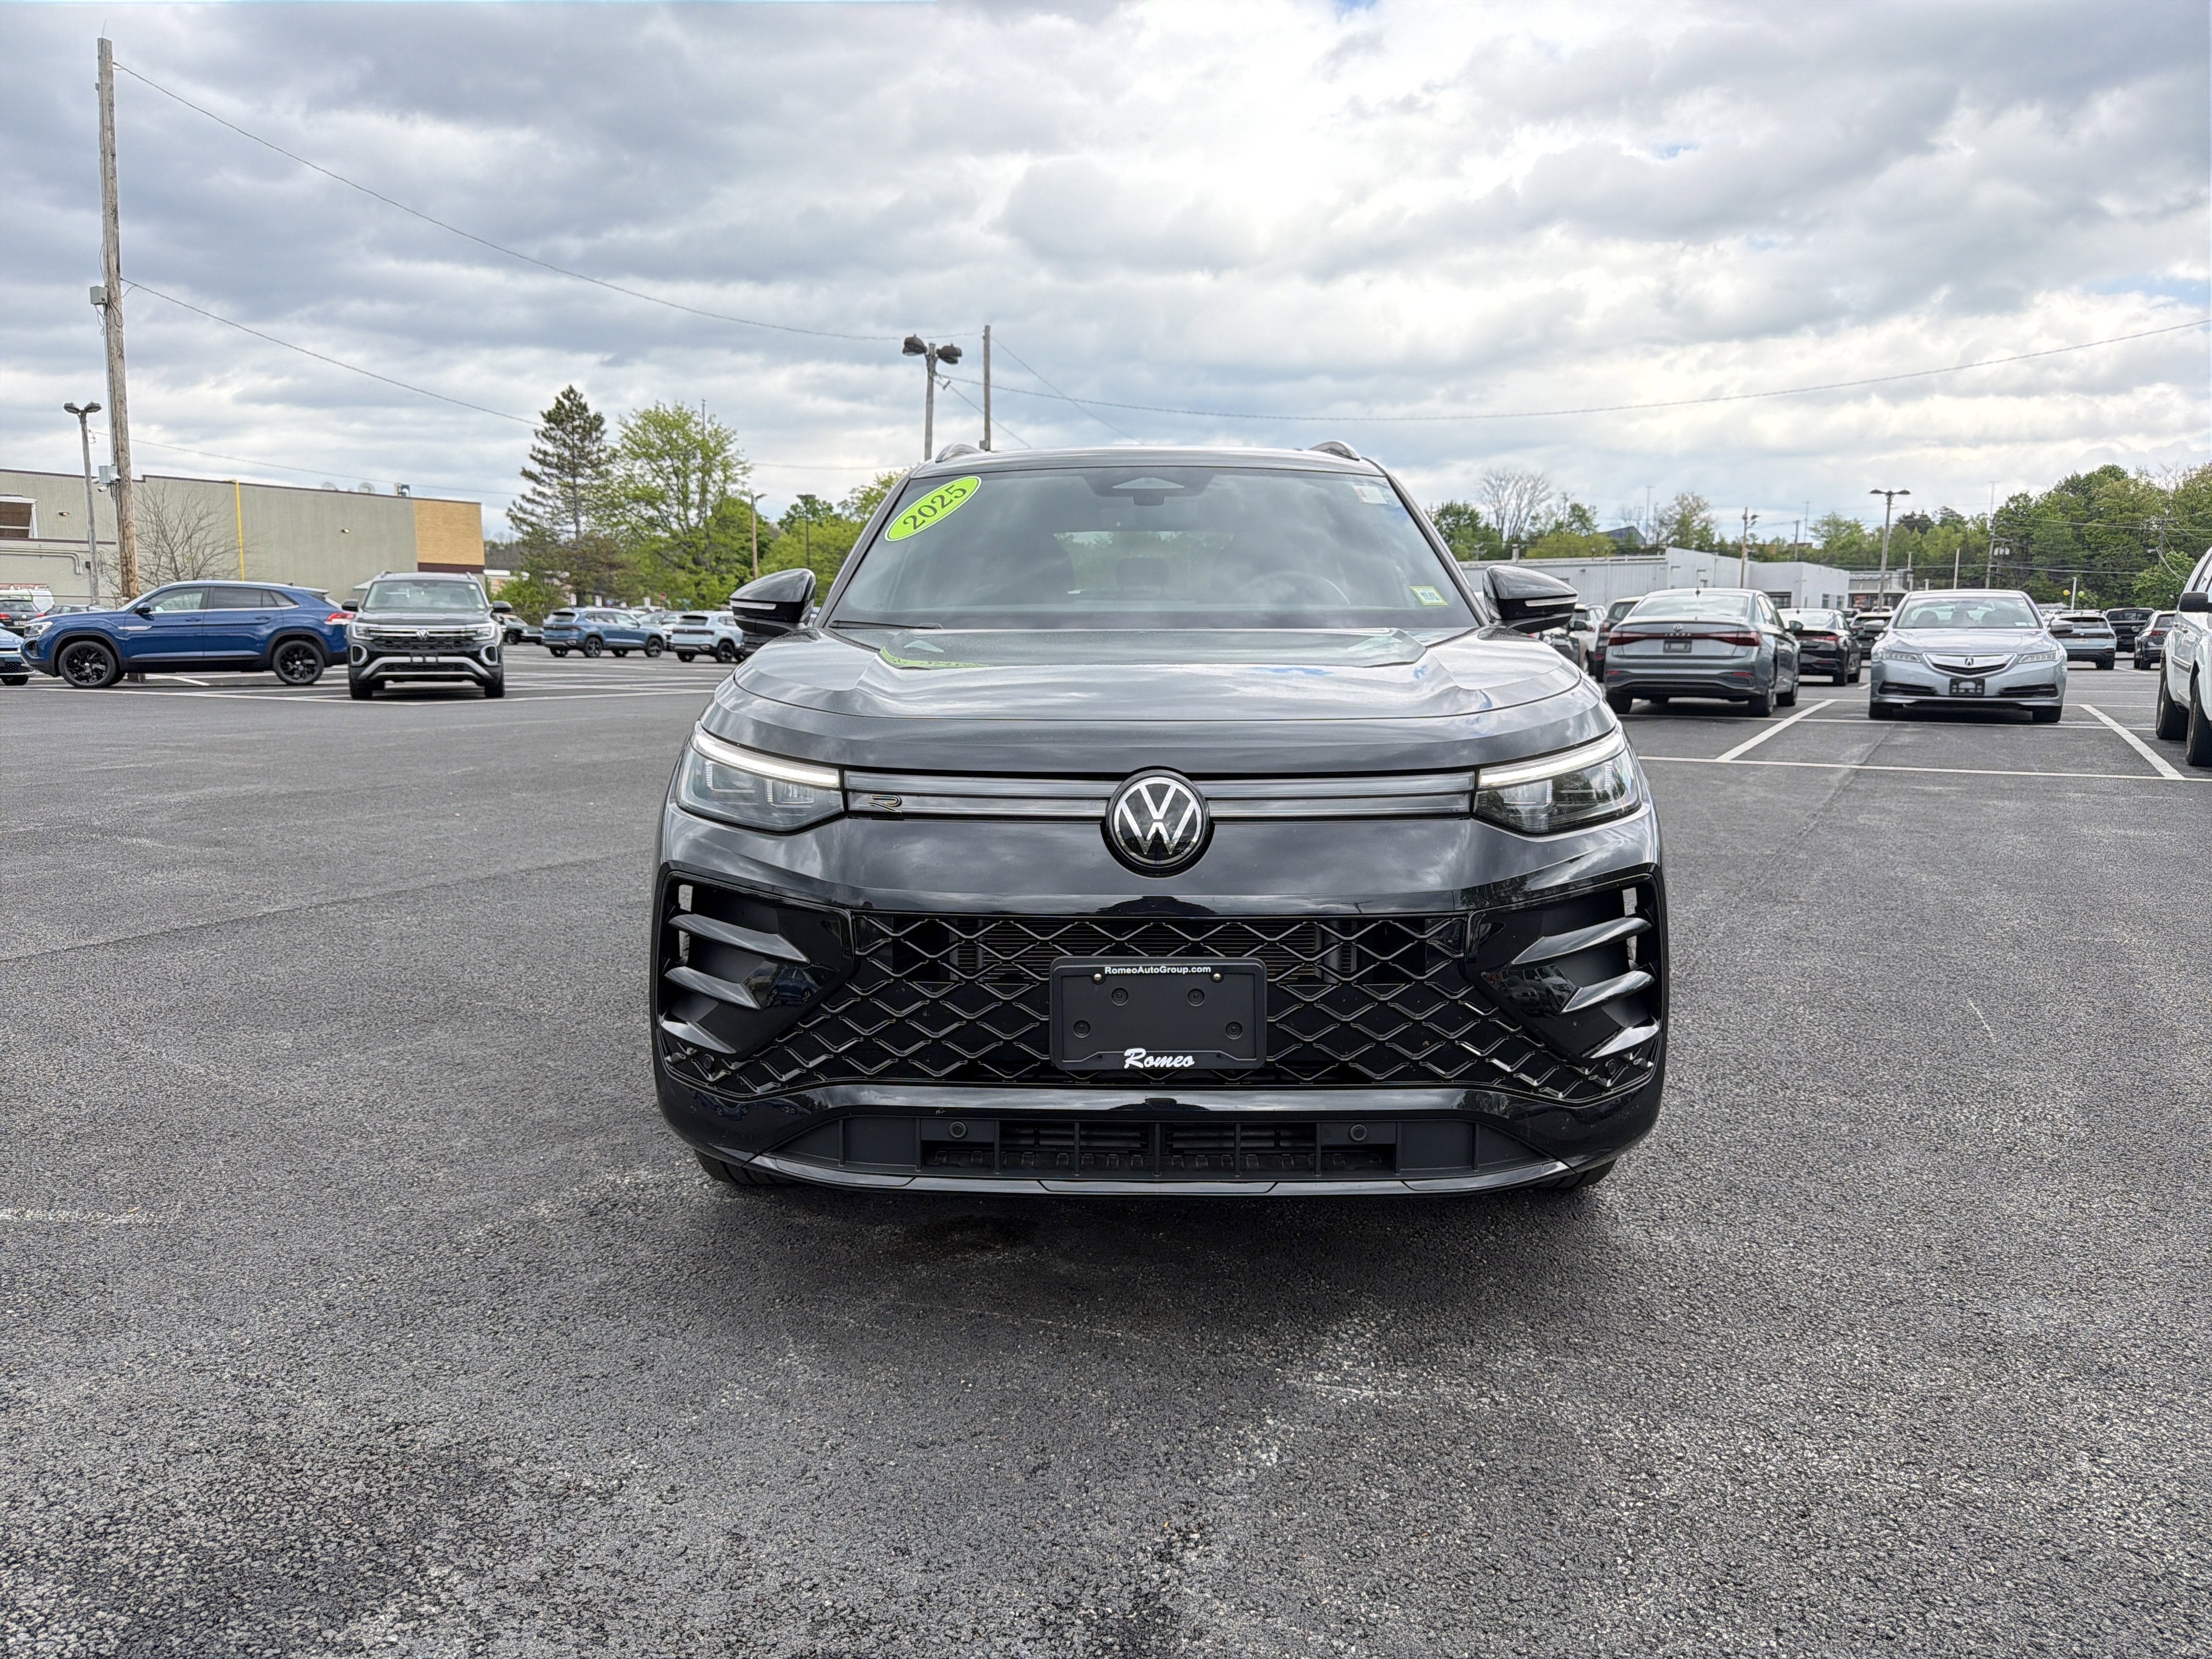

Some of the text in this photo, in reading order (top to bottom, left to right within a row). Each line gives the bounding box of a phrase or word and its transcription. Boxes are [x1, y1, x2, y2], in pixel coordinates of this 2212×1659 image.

[903, 484, 967, 530] 2025
[1117, 780, 1198, 859] VW
[1104, 966, 1211, 974] RomeoAutoGroup.com
[1124, 1048, 1195, 1069] Romeo
